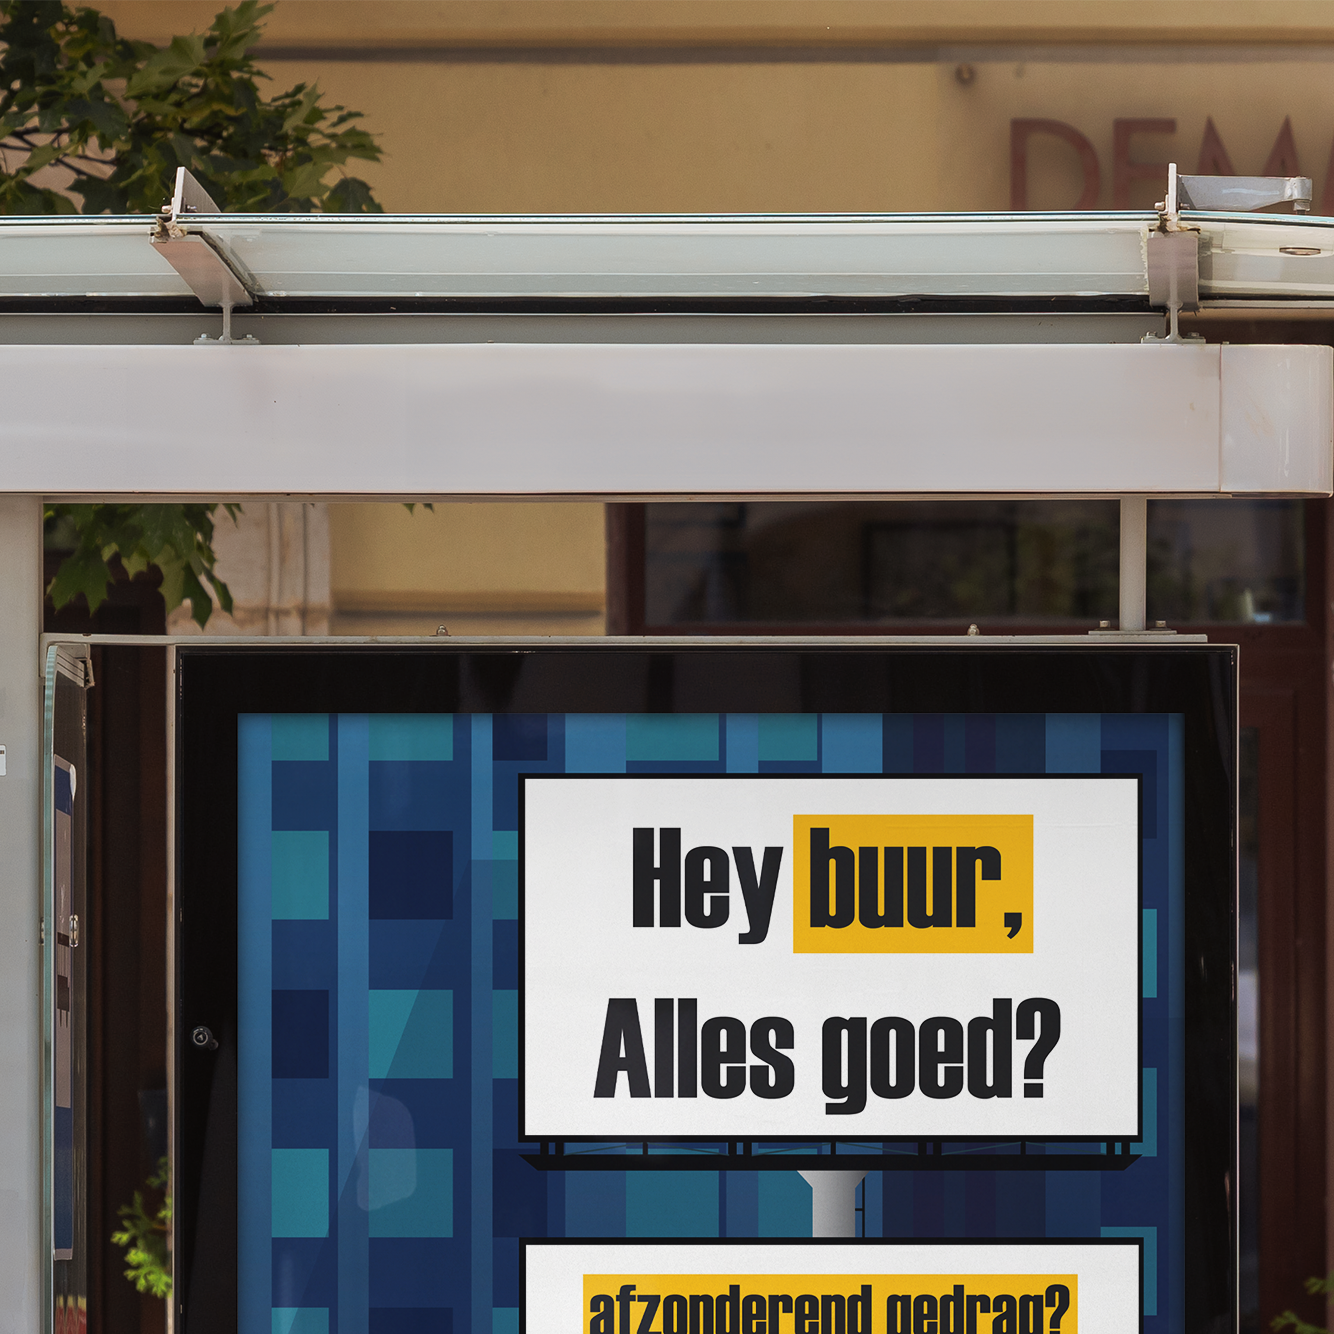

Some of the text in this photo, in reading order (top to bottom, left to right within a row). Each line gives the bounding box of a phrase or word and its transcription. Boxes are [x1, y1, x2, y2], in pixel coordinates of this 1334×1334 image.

[633, 828, 1022, 944] Hey buur,
[594, 998, 1061, 1115] Alles goed?
